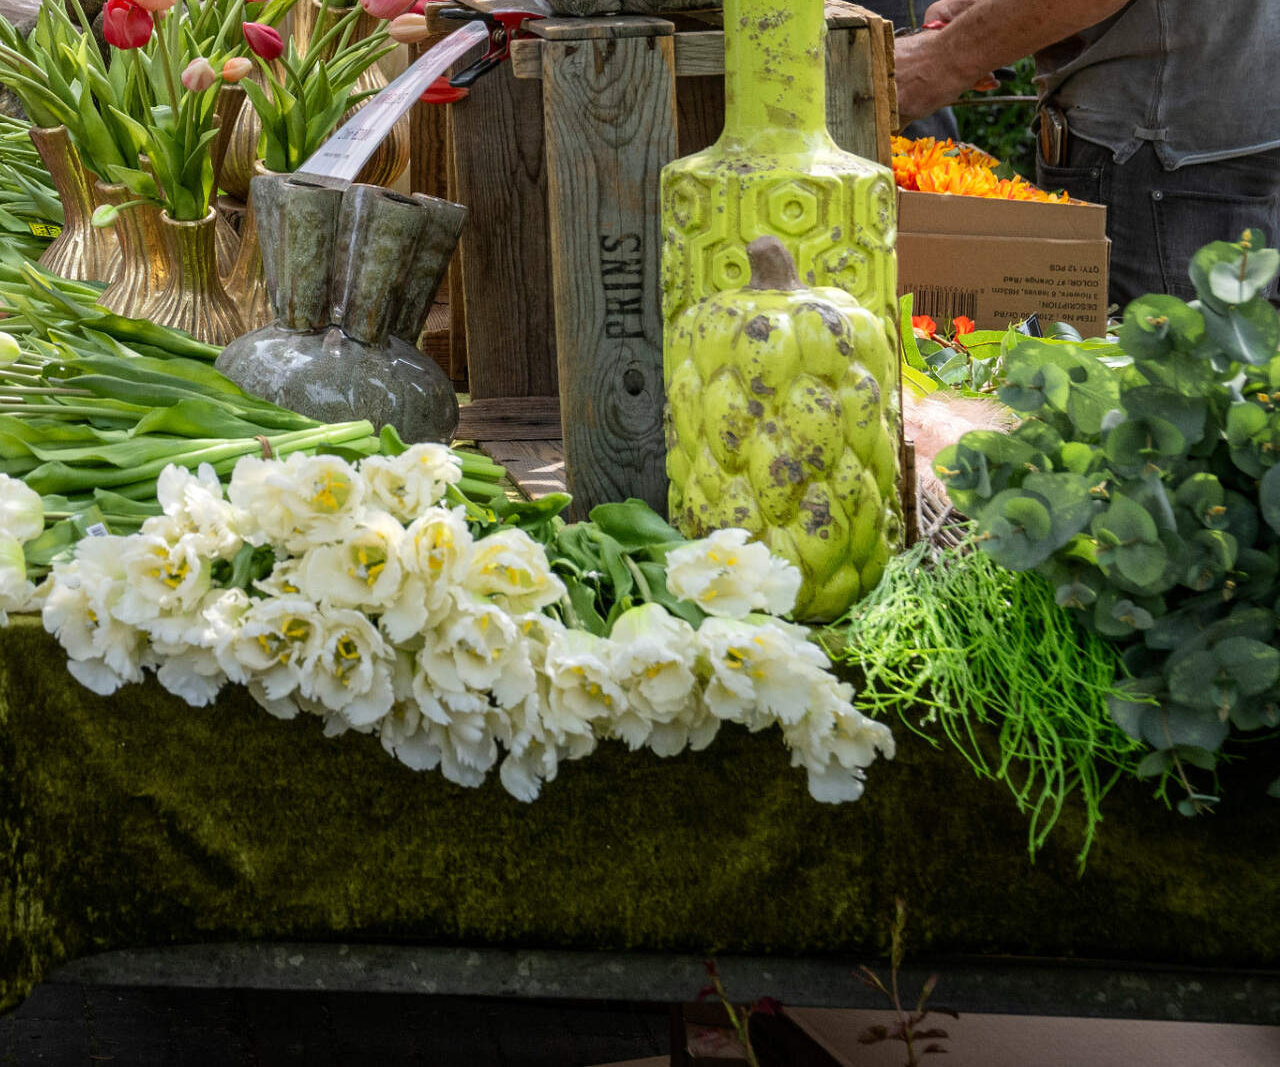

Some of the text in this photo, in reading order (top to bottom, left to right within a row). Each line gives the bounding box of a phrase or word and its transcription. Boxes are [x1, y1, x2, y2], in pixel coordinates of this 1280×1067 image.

[1049, 264, 1066, 272] PCS
[1080, 265, 1100, 274] QTY:
[601, 233, 644, 339] PRINS
[1025, 277, 1054, 286] Orange
[1068, 279, 1099, 287] COLOR:
[1038, 301, 1097, 311] DESCRIPTION:
[1075, 314, 1097, 322] ITEM
